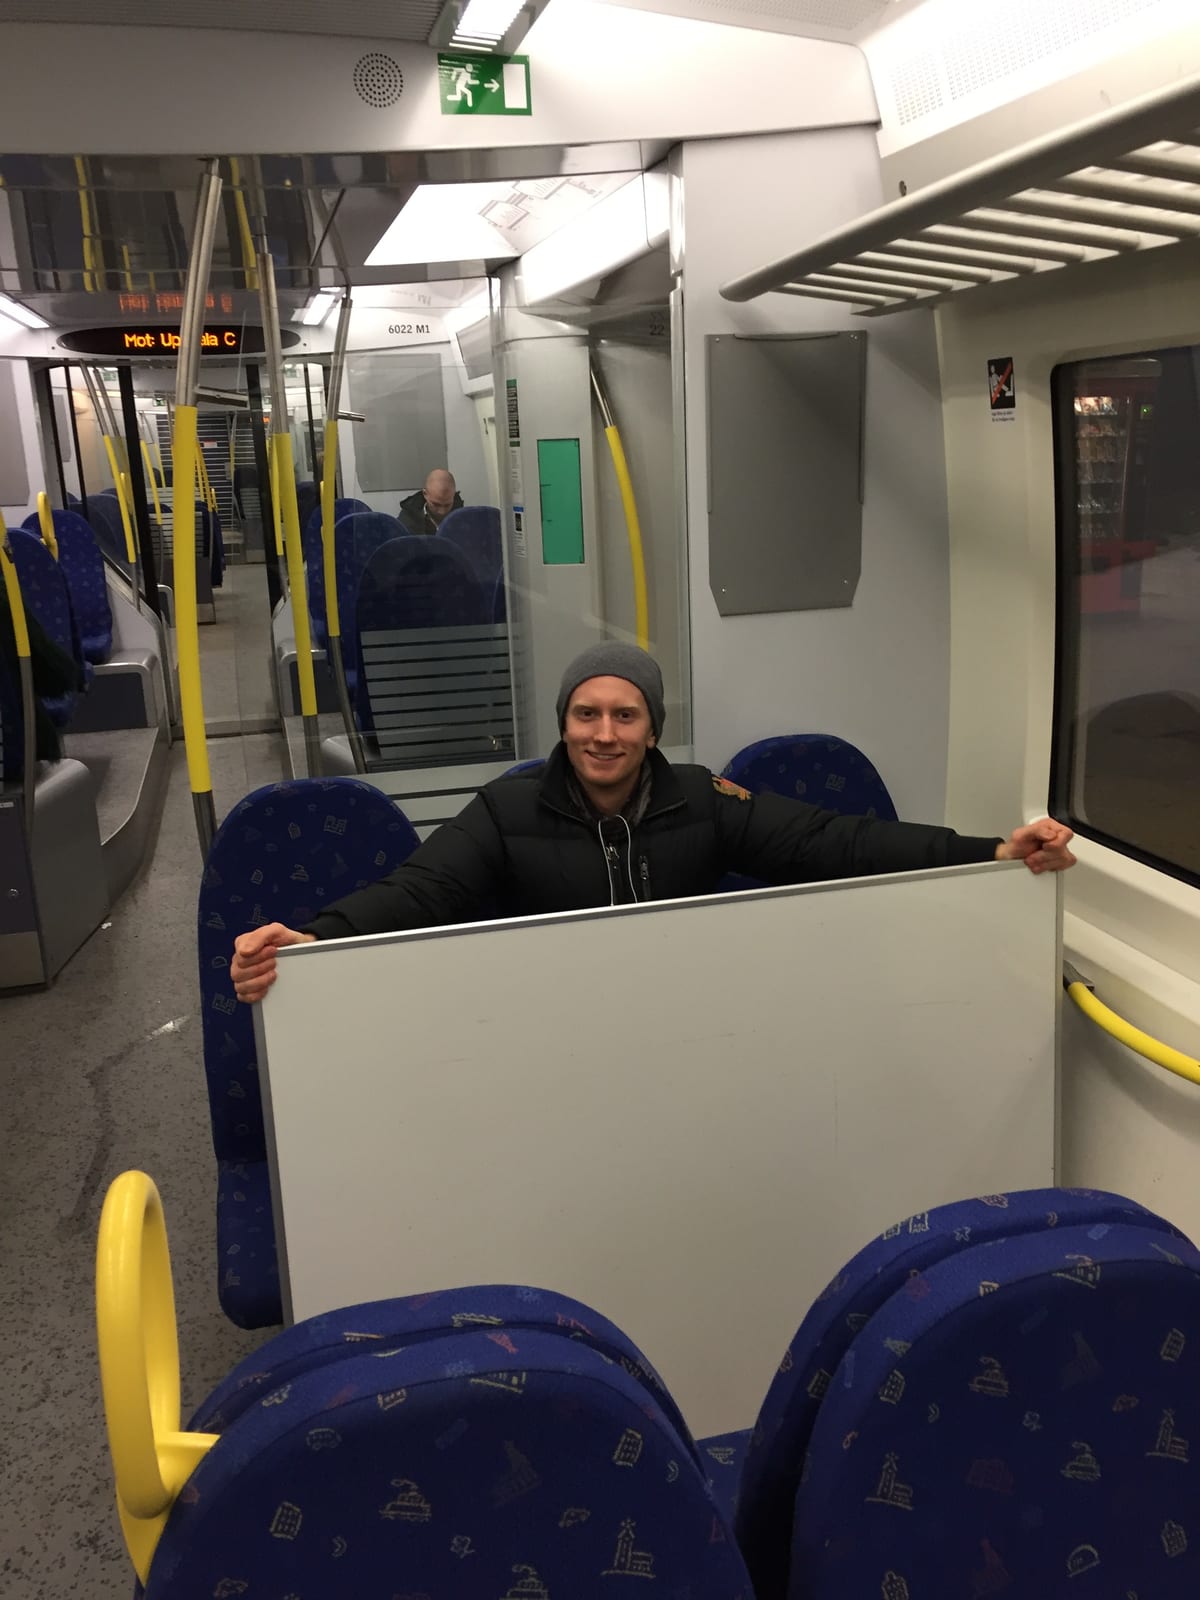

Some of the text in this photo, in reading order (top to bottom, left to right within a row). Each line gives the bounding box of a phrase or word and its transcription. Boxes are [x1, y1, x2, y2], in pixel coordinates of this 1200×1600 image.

[388, 324, 431, 334] 6022 M1
[124, 331, 236, 349] Mot: Upala C
